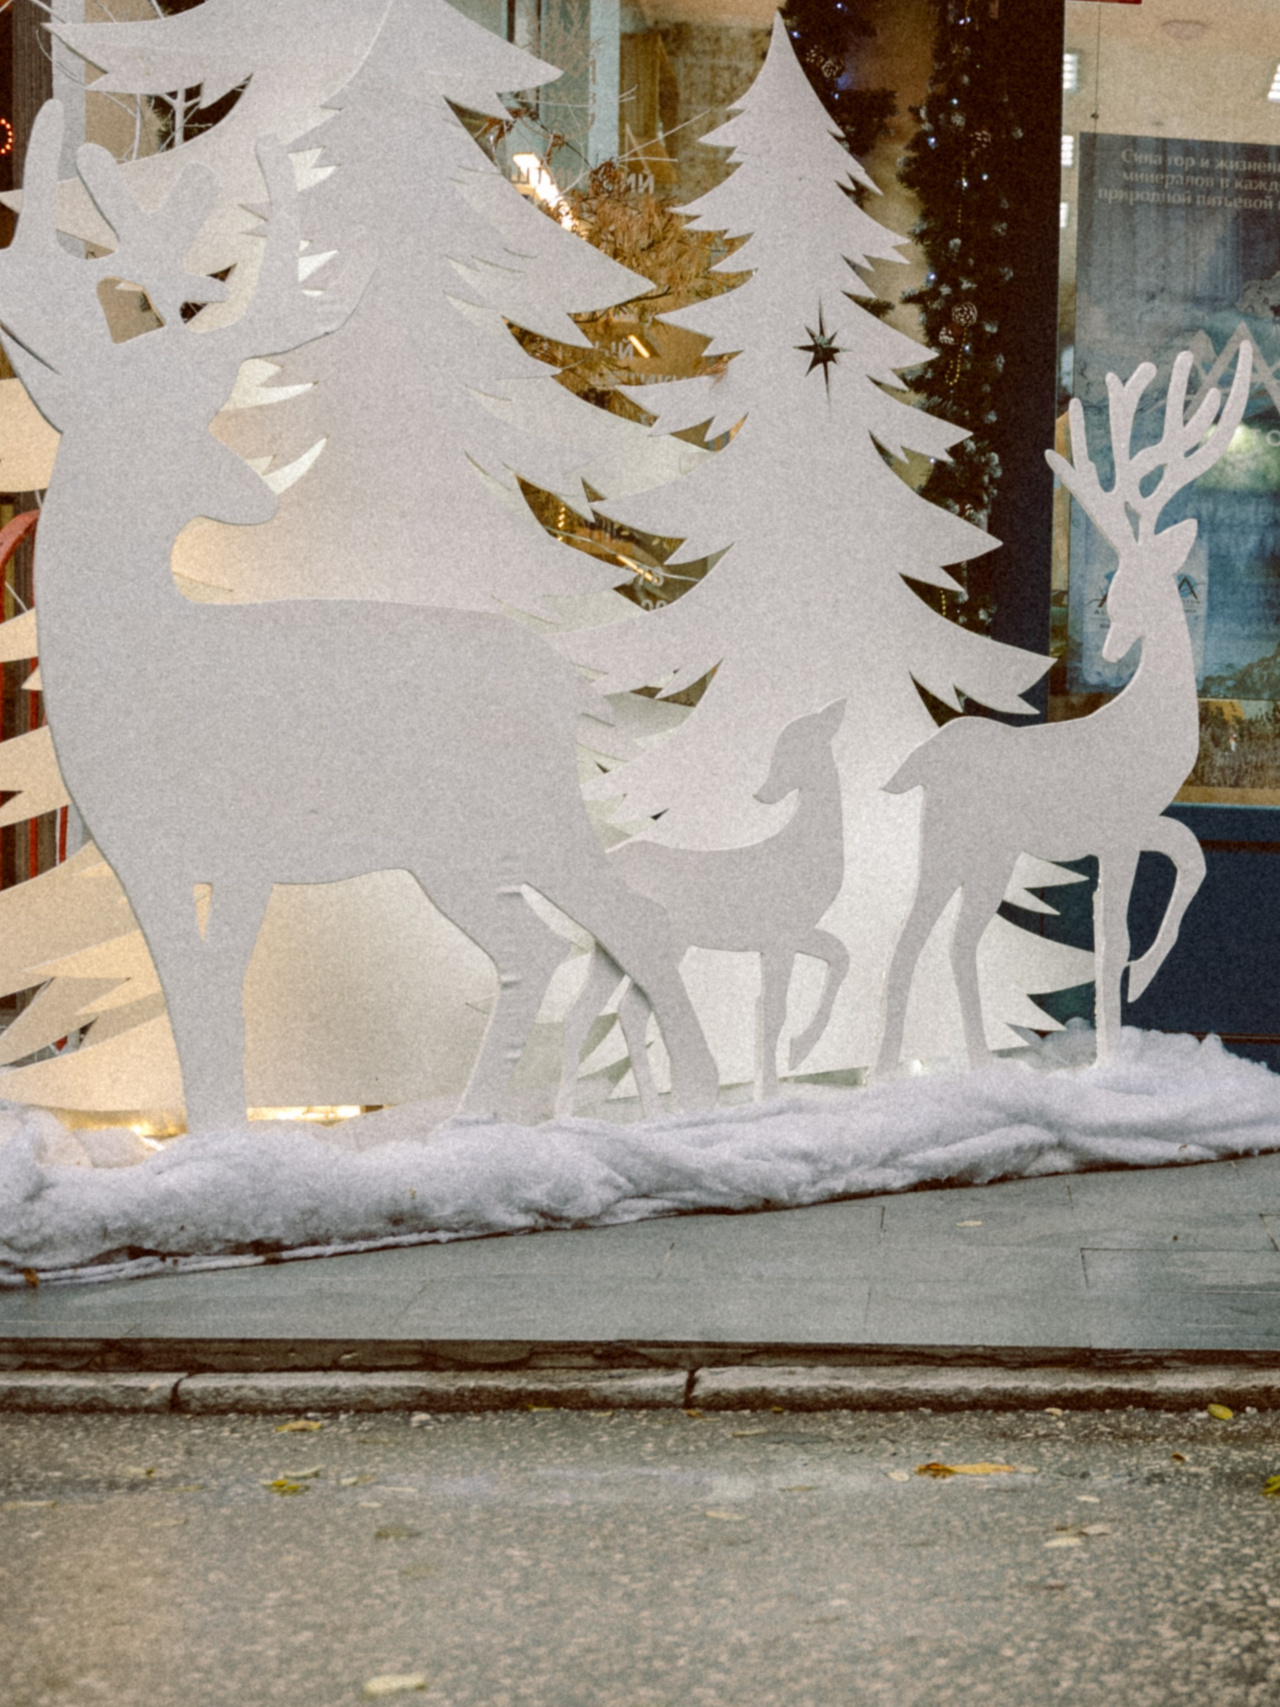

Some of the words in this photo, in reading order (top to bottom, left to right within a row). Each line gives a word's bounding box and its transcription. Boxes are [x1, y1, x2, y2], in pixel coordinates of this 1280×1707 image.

[1200, 158, 1210, 168] и
[1123, 171, 1214, 189] минералов
[1221, 176, 1229, 188] в
[1099, 187, 1192, 206] природной
[1197, 194, 1273, 210] питьевой
